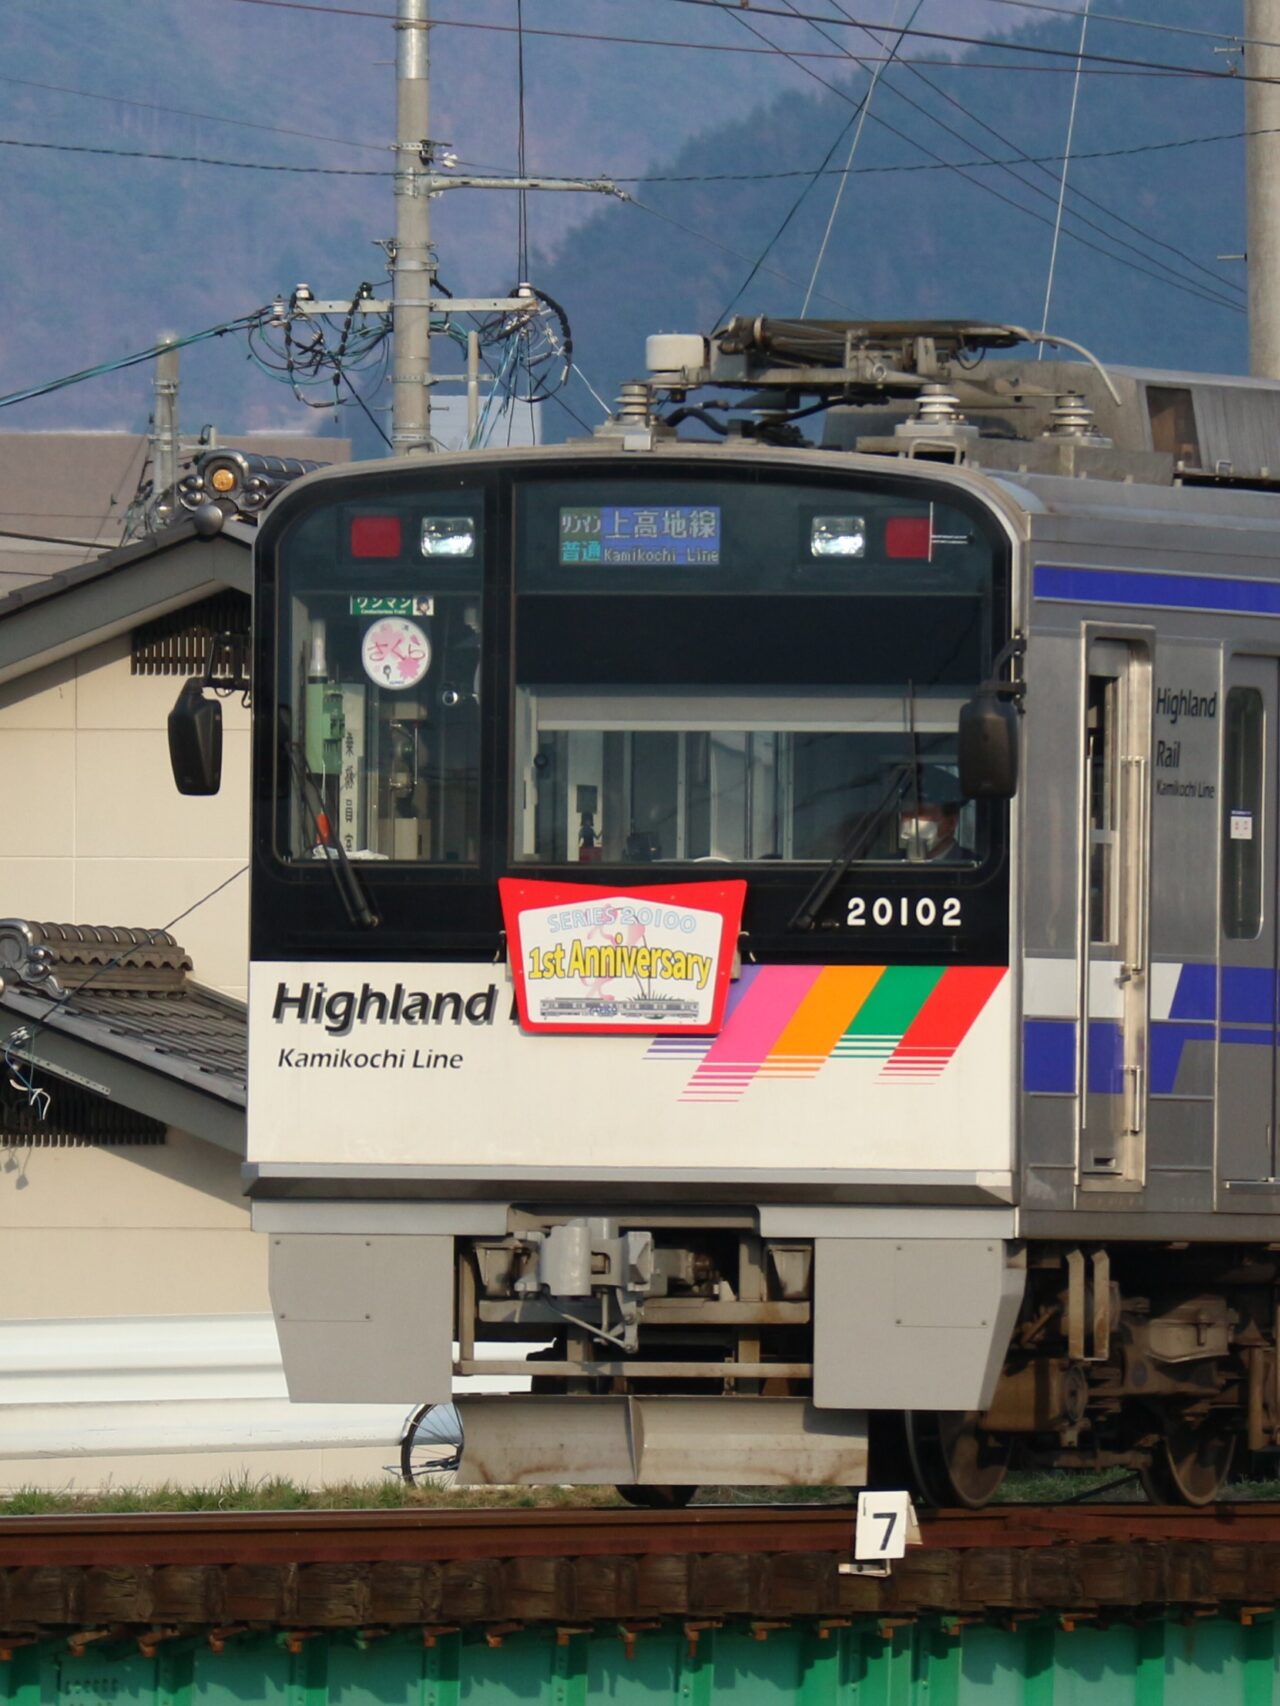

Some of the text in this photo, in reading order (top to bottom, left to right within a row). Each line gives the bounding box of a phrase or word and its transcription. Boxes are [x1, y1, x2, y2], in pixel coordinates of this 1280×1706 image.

[604, 510, 717, 539] 上高地線
[561, 540, 601, 562] 普通
[604, 547, 719, 562] Kamikochi Line
[356, 596, 412, 609] ワンマン
[367, 638, 426, 662] さくら
[1156, 687, 1217, 724] Highland
[1156, 740, 1181, 768] Rail
[1157, 779, 1215, 798] Kamikochi Line
[547, 905, 697, 934] SERIES 20100
[847, 896, 962, 927] 20102
[528, 932, 713, 990] 1st Anniversary
[271, 981, 498, 1034] Highland
[278, 1046, 464, 1070] Kamikochi Line
[872, 1511, 898, 1551] 7
